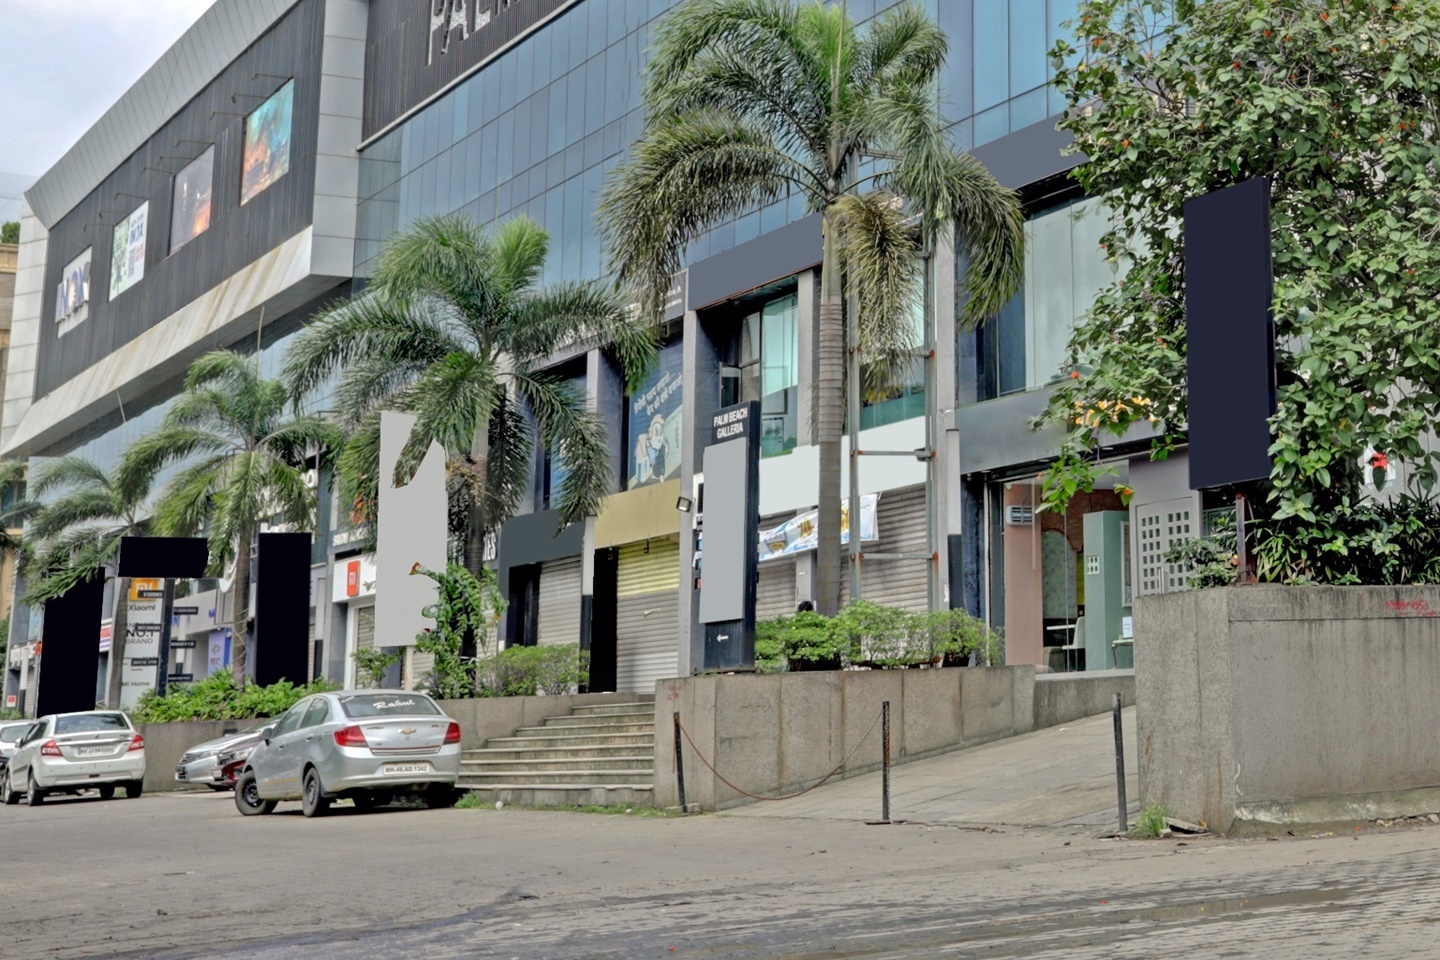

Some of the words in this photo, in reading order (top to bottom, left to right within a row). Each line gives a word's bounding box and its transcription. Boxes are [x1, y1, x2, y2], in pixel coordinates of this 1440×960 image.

[713, 413, 729, 427] PALM
[728, 406, 748, 422] BEACH
[716, 421, 744, 439] GALLERIA
[128, 602, 156, 612] Xiaomi
[125, 637, 154, 645] BRAND
